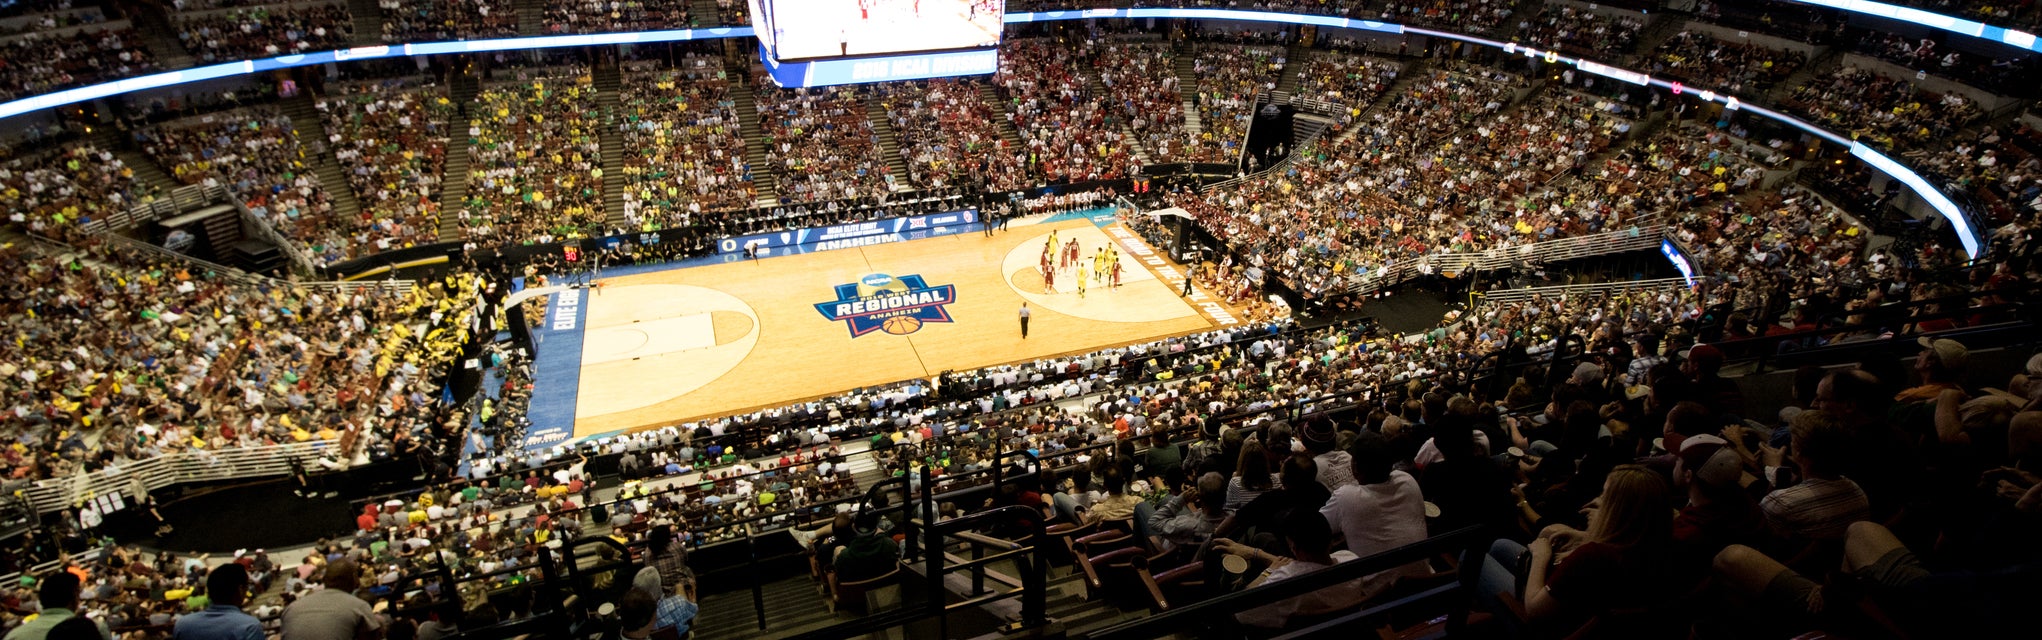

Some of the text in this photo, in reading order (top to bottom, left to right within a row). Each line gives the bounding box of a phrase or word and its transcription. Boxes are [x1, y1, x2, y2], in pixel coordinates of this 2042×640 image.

[852, 53, 993, 80] 2016 NCAA DIVISION
[815, 233, 898, 252] ANAHEIM
[866, 277, 892, 286] NCAA
[836, 290, 944, 316] REGIONAL
[869, 308, 921, 320] ANAHEIM
[1197, 302, 1239, 326] FOUR
